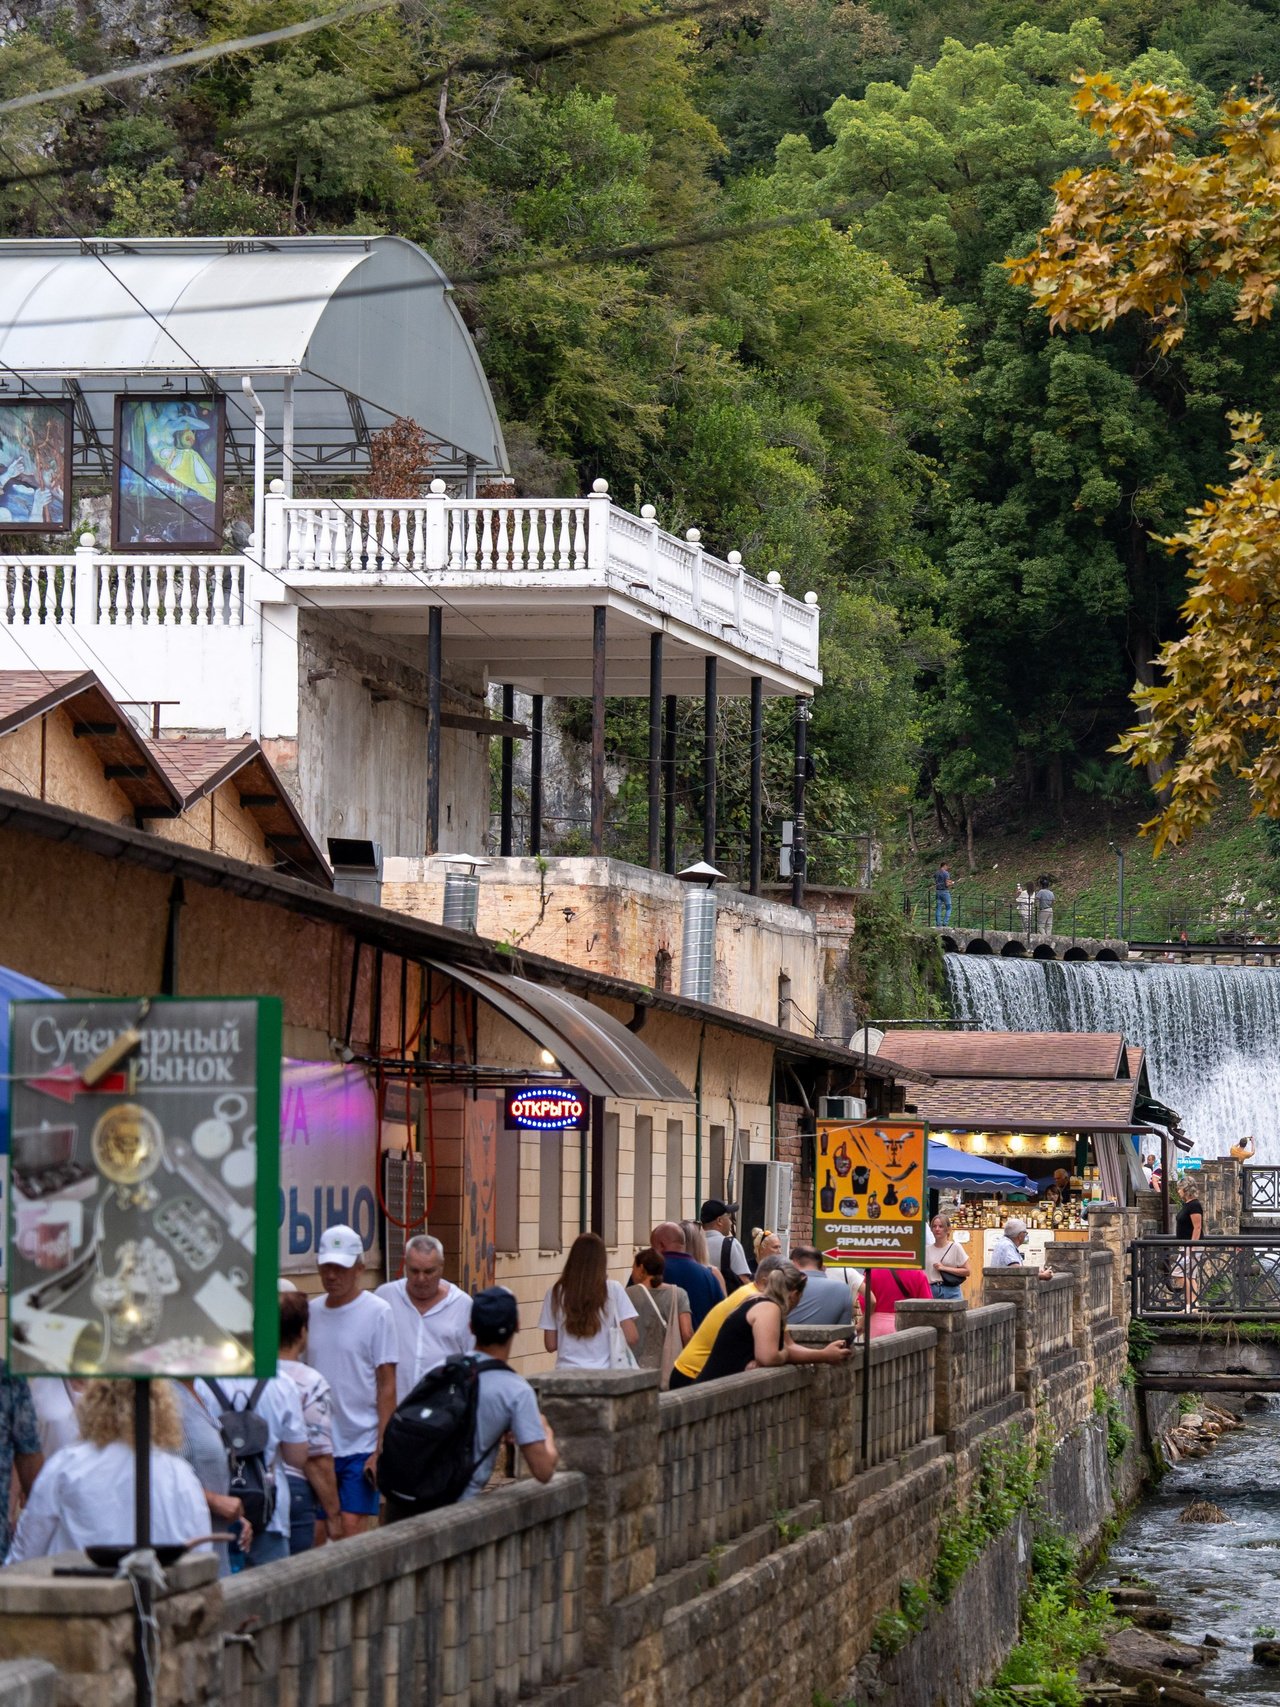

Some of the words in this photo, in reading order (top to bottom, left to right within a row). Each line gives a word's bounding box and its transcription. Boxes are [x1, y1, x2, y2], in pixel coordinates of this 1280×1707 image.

[511, 1100, 583, 1117] ОТКРЫТО
[824, 1224, 914, 1235] СУВЕНИРНАЯ
[836, 1237, 901, 1247] ЯРМАРКА
